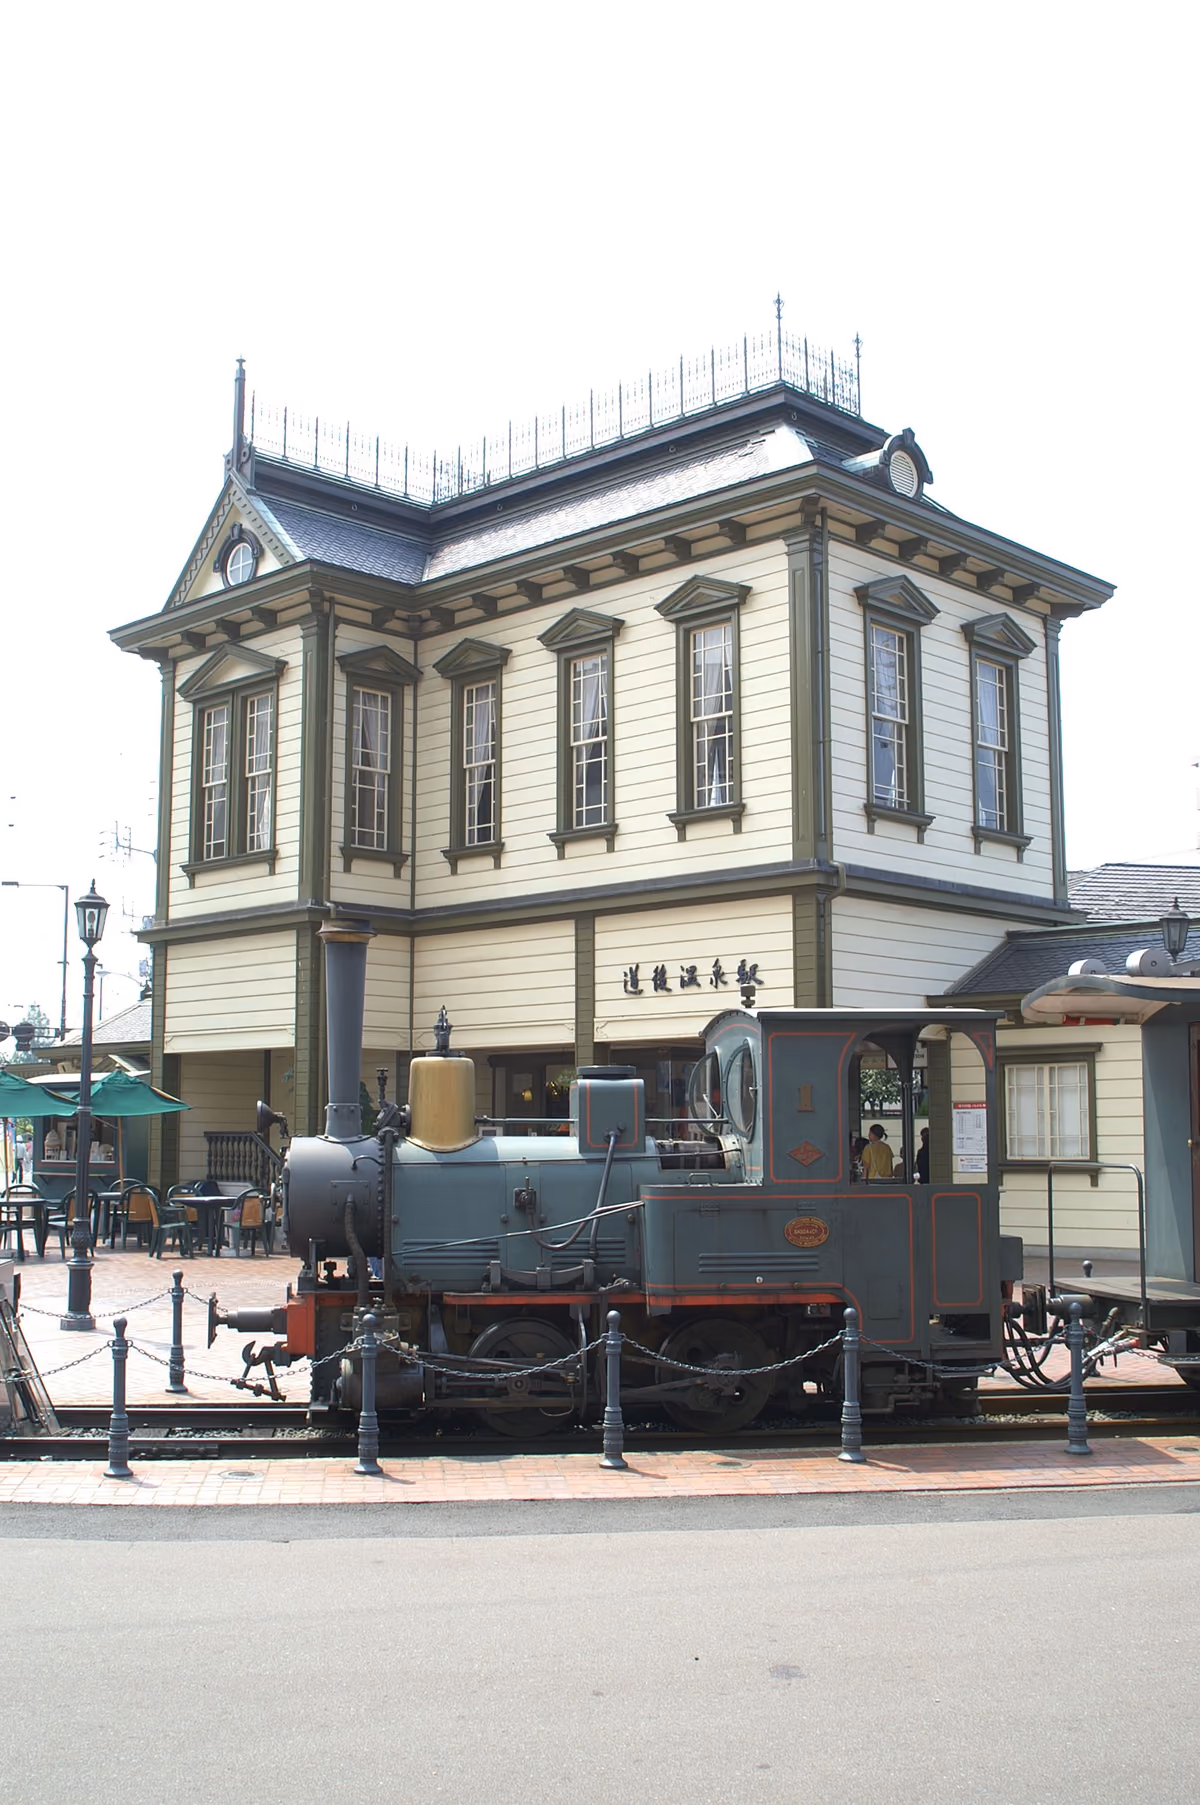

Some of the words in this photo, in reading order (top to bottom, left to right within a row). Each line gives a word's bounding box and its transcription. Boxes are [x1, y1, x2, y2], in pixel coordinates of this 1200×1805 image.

[623, 958, 764, 995] 道後温泉駅
[797, 1083, 815, 1112] 1
